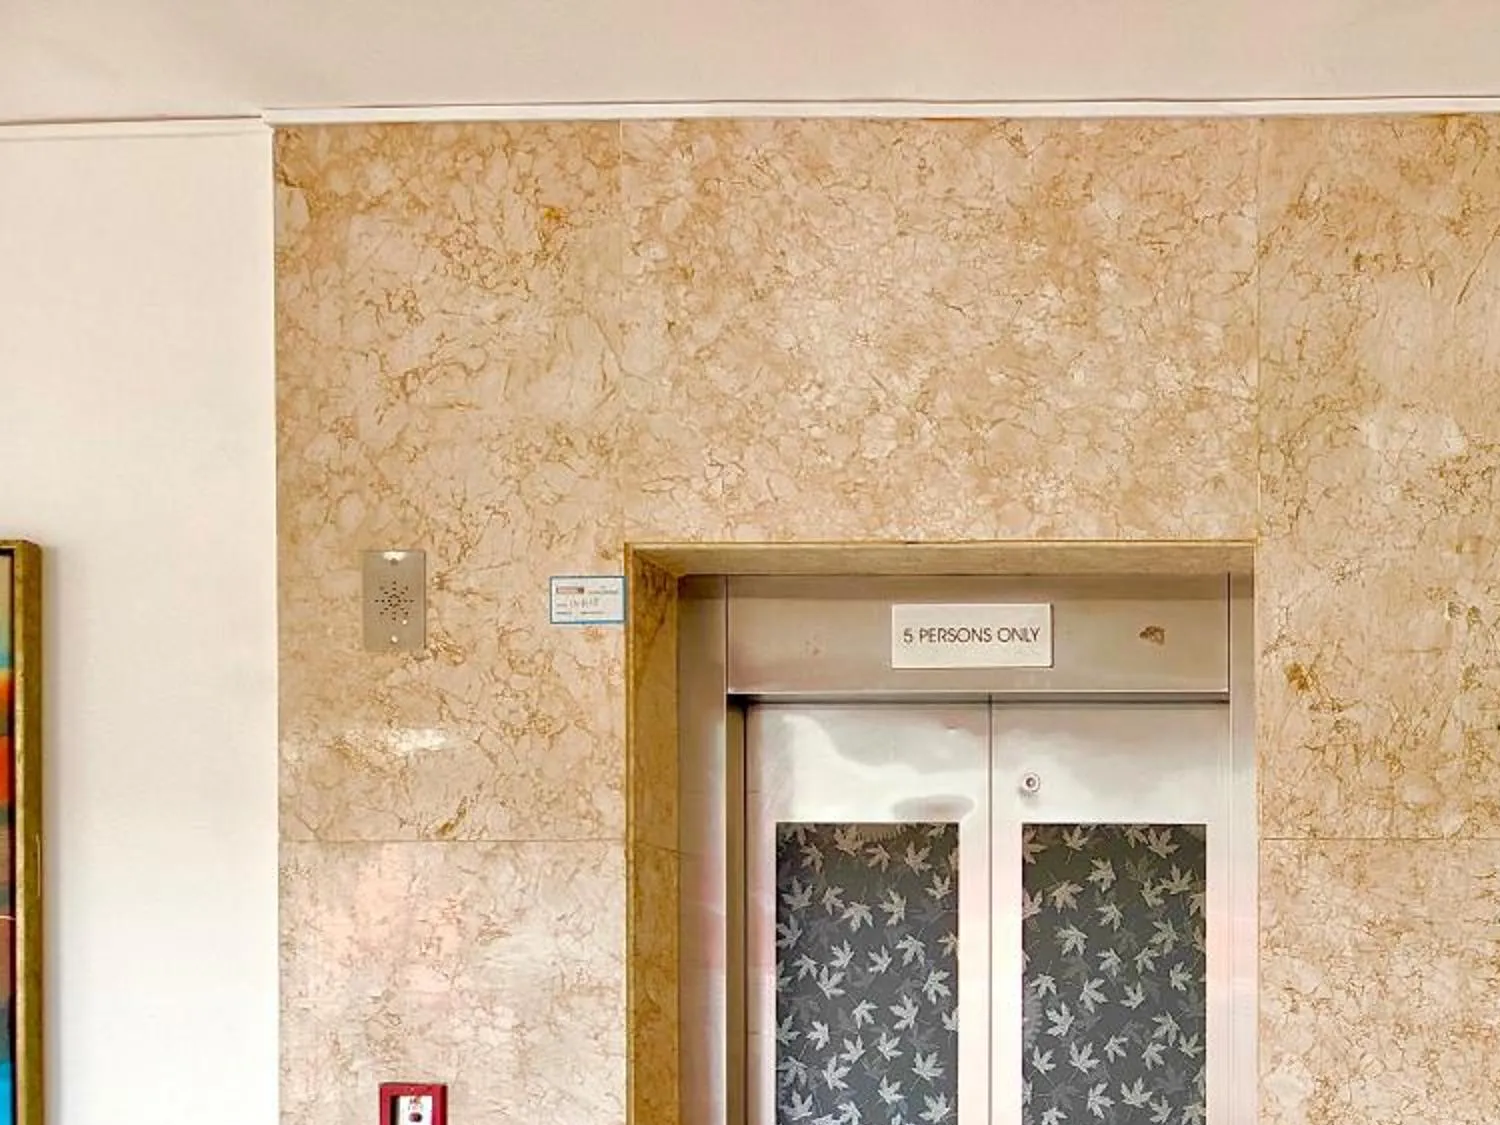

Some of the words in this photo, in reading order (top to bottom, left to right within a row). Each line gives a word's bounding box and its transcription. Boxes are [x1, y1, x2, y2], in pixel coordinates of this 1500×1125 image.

[903, 627, 914, 643] 5
[919, 627, 993, 643] PERSONS
[997, 627, 1041, 643] ONLY
